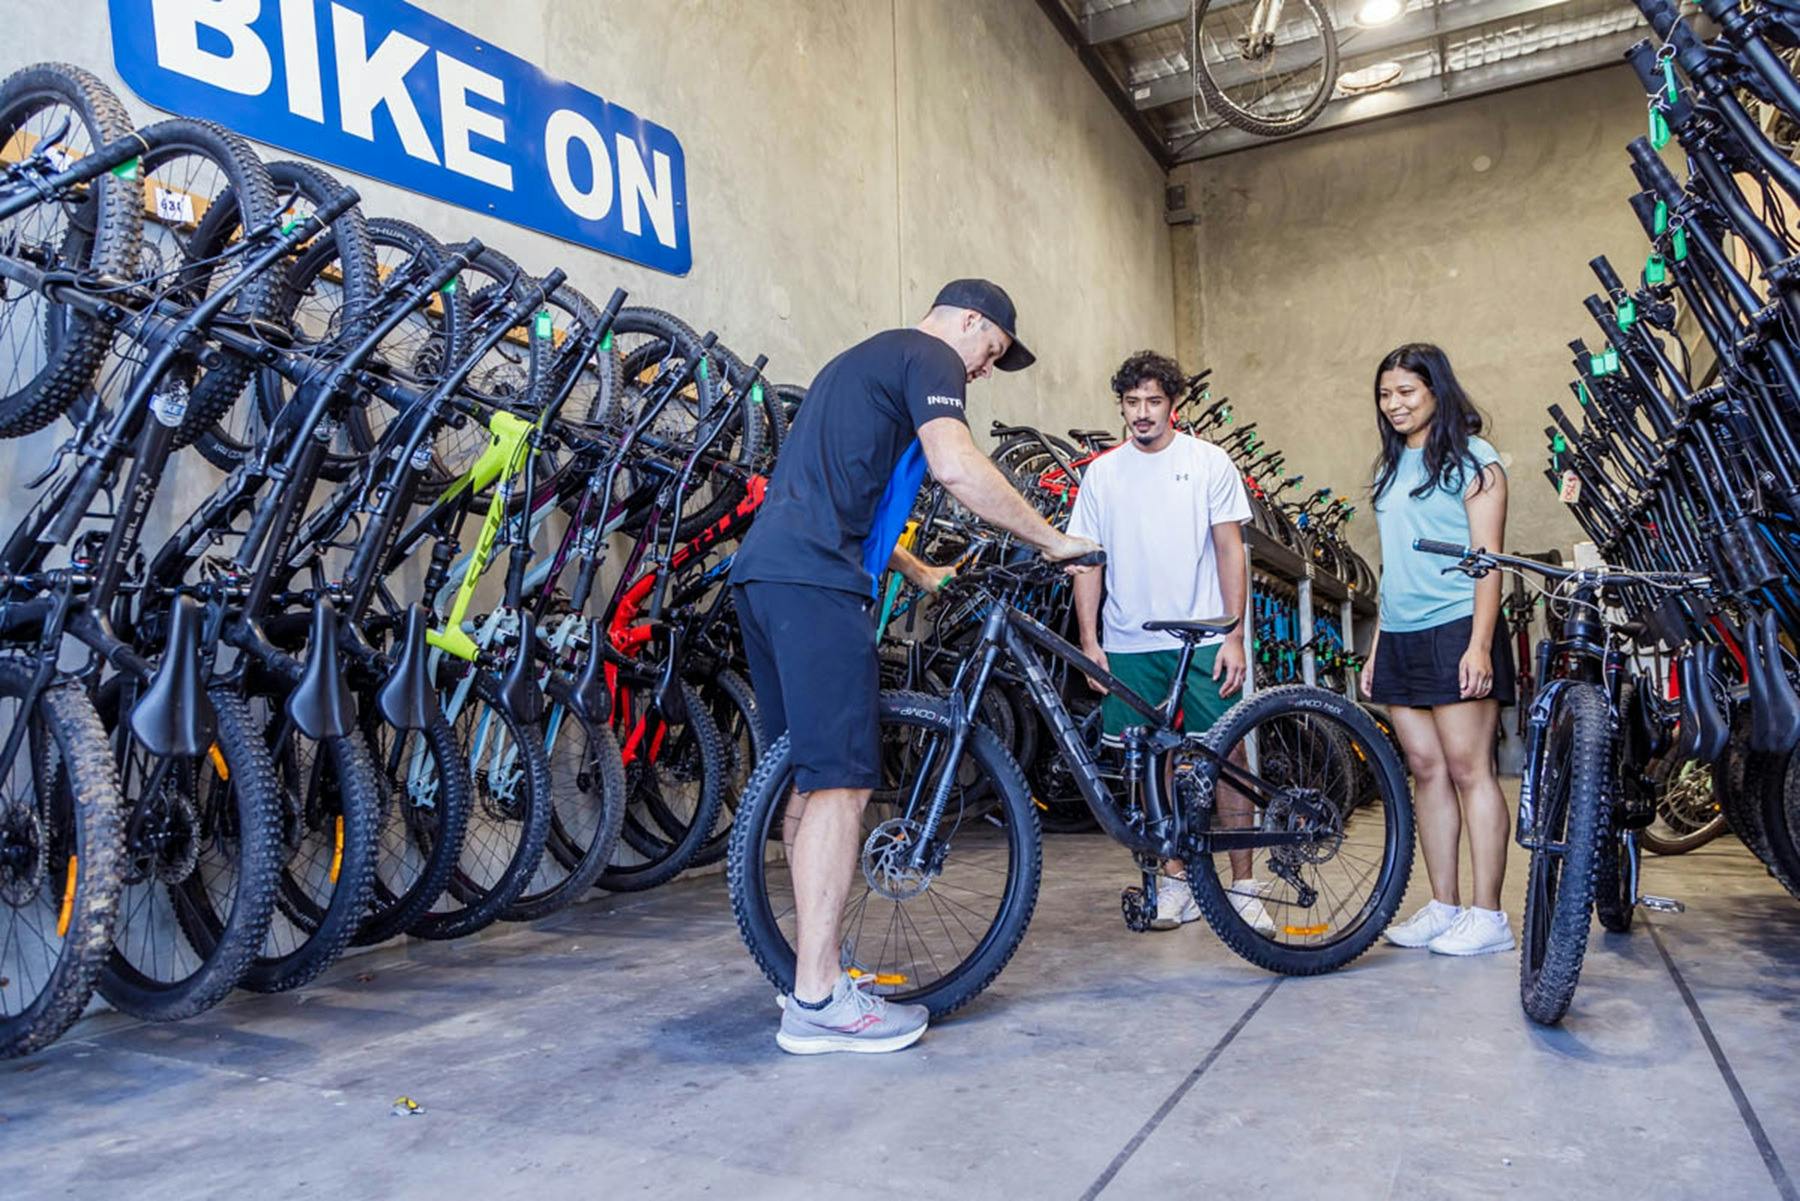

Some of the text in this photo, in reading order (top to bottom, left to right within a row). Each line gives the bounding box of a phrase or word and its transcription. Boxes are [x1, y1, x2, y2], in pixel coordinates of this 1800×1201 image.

[151, 0, 678, 250] BIKE ON
[116, 515, 142, 564] FUEL
[899, 706, 936, 720] COMP
